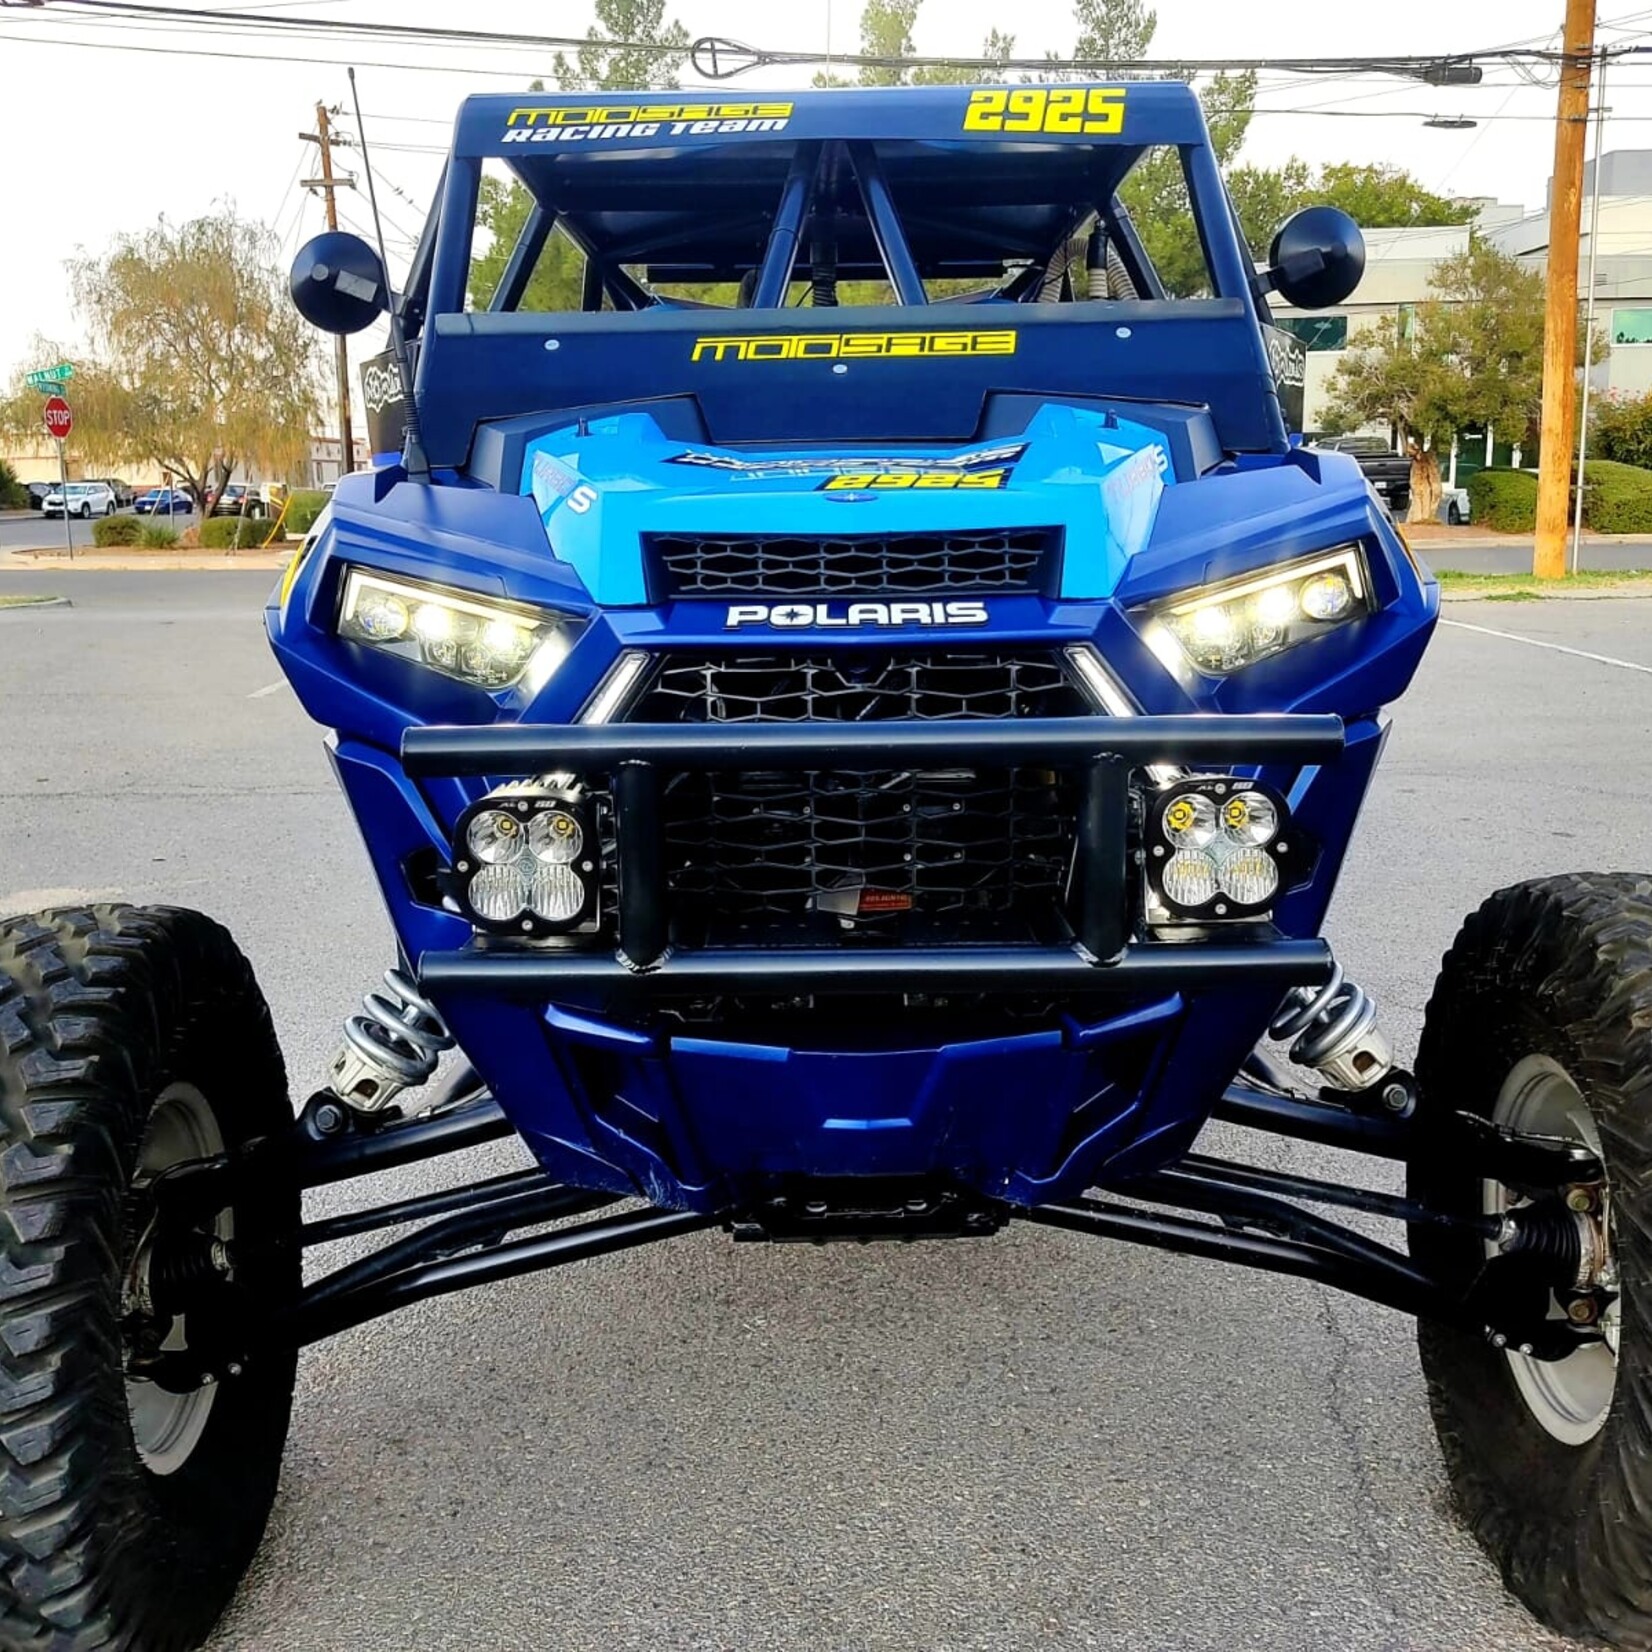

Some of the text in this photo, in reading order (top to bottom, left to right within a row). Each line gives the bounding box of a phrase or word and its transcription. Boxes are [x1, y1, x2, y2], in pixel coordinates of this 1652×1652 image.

[506, 102, 794, 126] MOTOSAGE
[963, 88, 1126, 133] 2925
[691, 330, 1017, 361] MOTOSAGE
[46, 410, 70, 425] STOP
[566, 484, 598, 514] S
[726, 601, 989, 627] POLARIS
